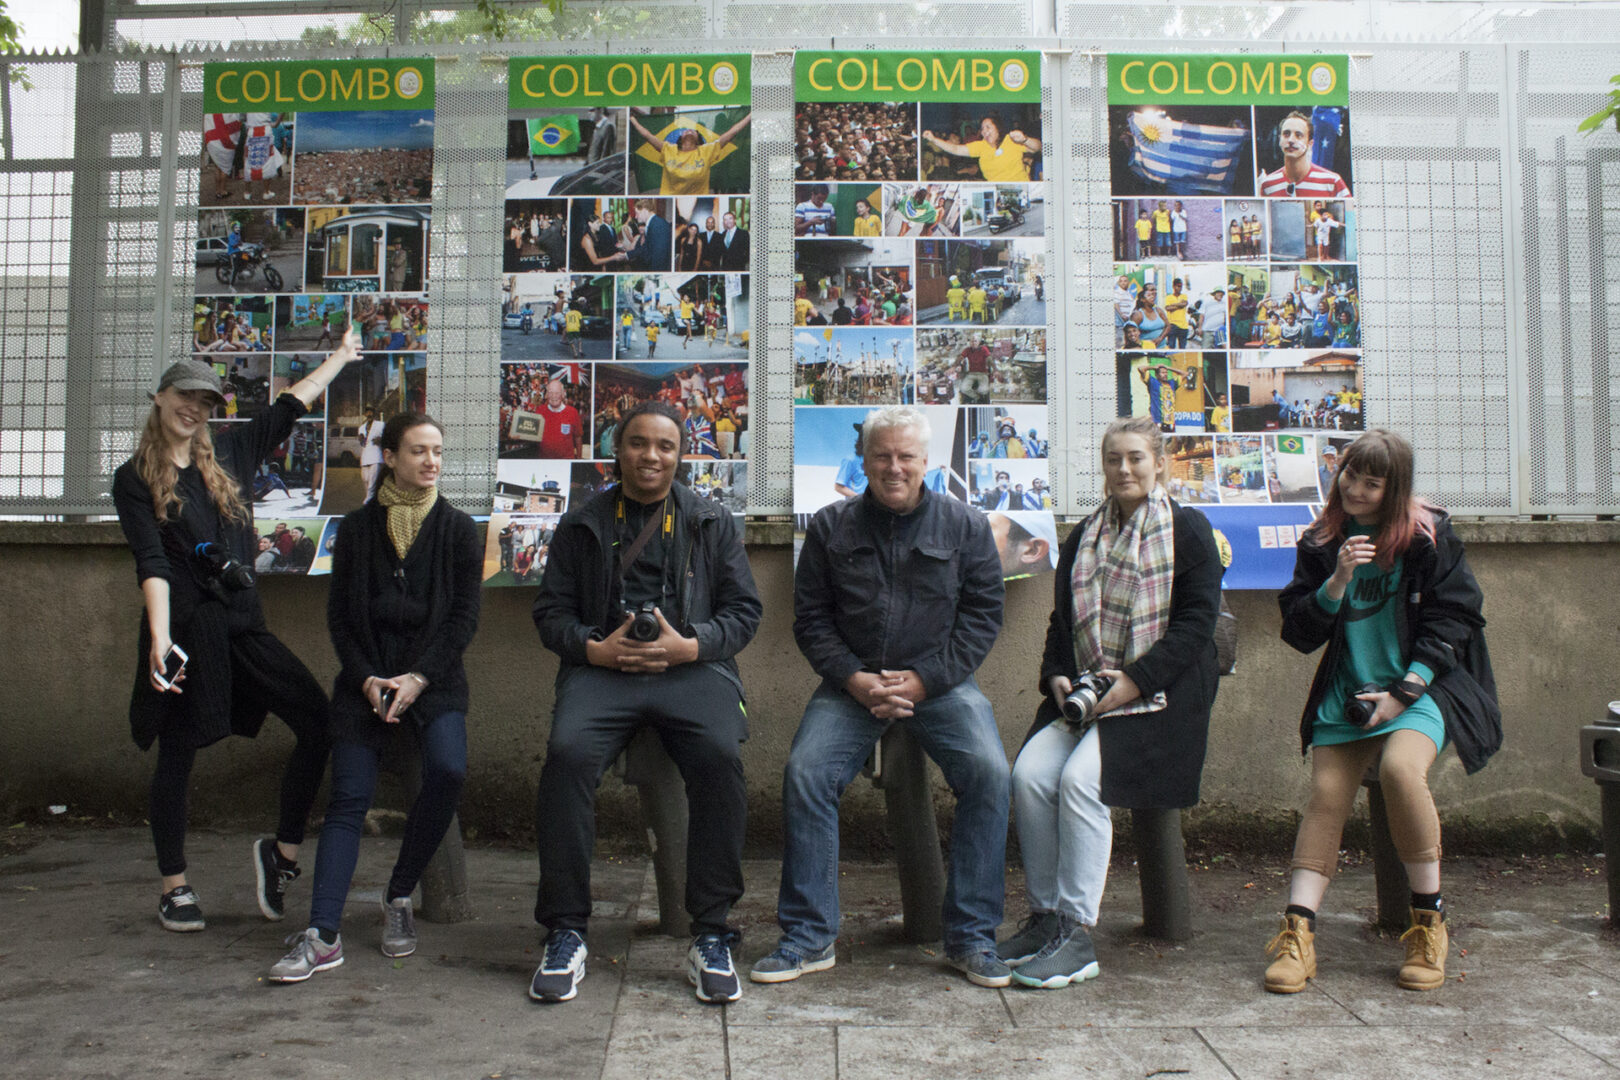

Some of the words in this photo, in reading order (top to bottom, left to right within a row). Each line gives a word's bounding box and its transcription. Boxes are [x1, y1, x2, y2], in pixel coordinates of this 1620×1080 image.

[215, 66, 423, 103] COLOMBO
[521, 61, 739, 97] COLOMBO
[808, 58, 1030, 92] COLOMBO
[1120, 61, 1337, 95] COLOMBO
[1353, 572, 1395, 602] NIKE
